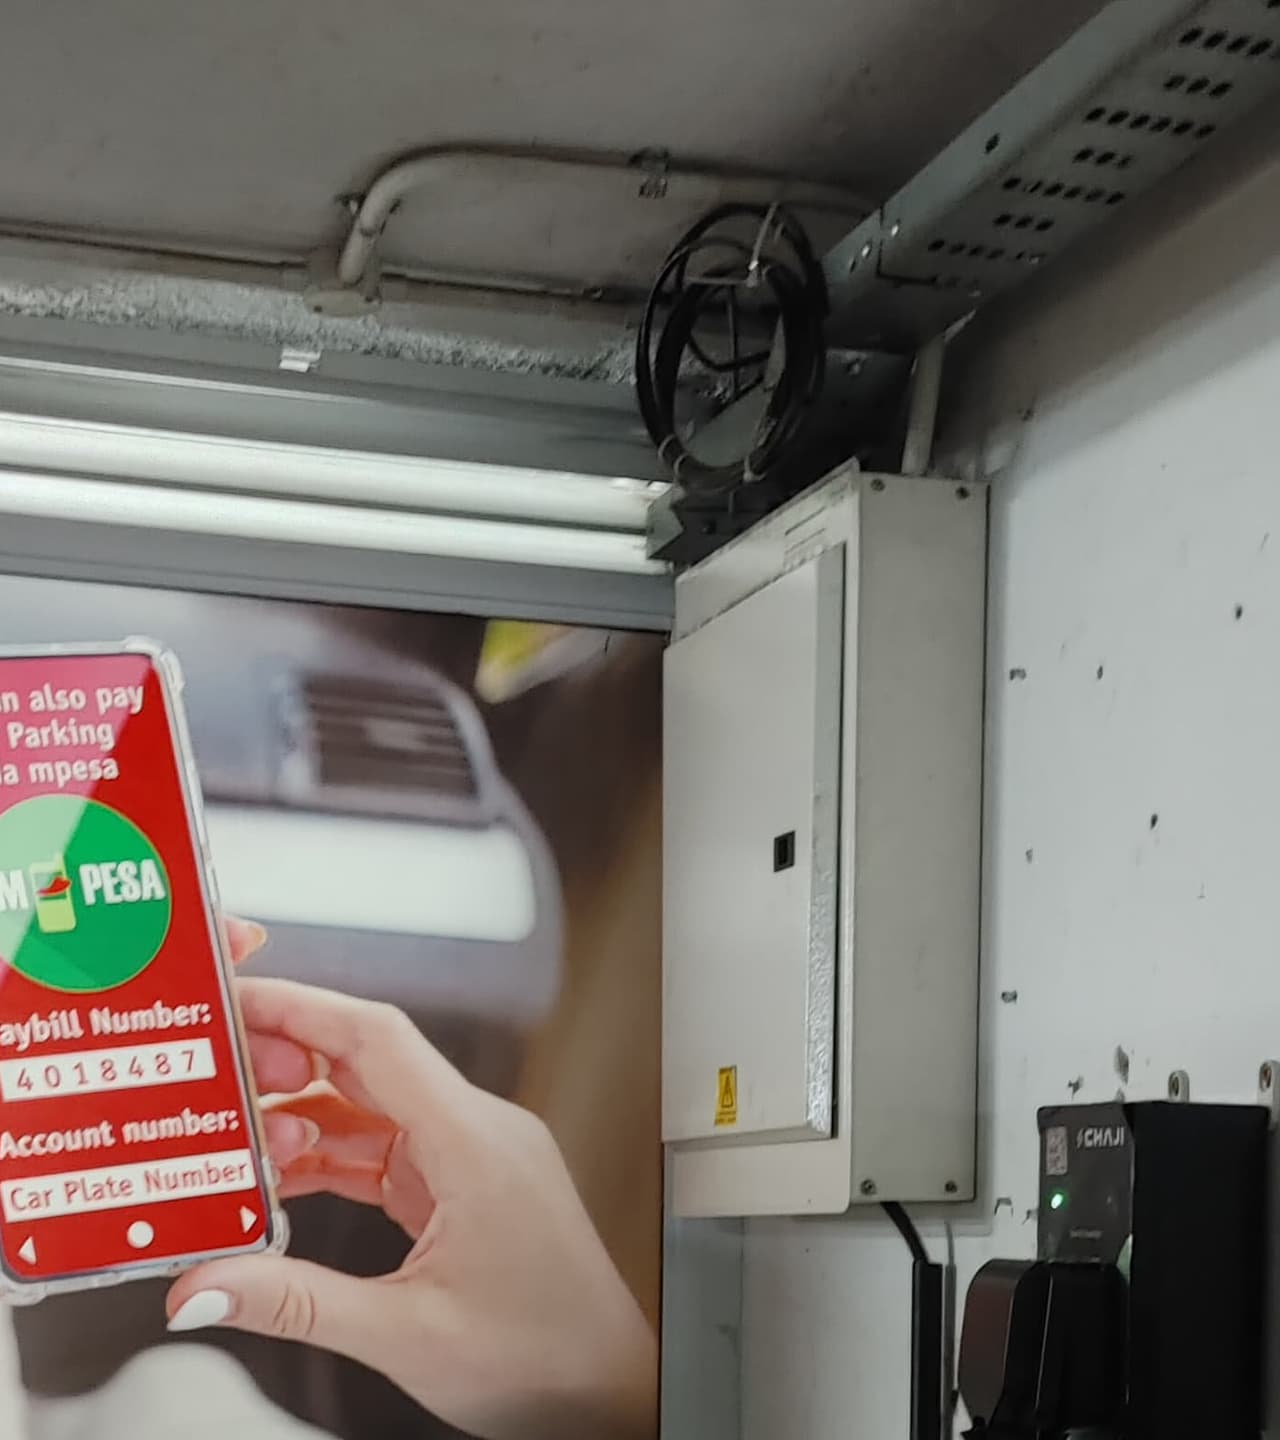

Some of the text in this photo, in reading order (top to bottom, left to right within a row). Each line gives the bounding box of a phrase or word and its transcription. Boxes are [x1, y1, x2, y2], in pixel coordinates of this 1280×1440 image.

[30, 684, 86, 712] also
[95, 684, 144, 715] pay
[7, 718, 116, 753] Parking
[28, 757, 119, 787] mpesa
[78, 858, 166, 905] PESA
[90, 1000, 211, 1035] Number:
[121, 1107, 239, 1144] number:
[9, 1160, 249, 1212] Car Plate Number
